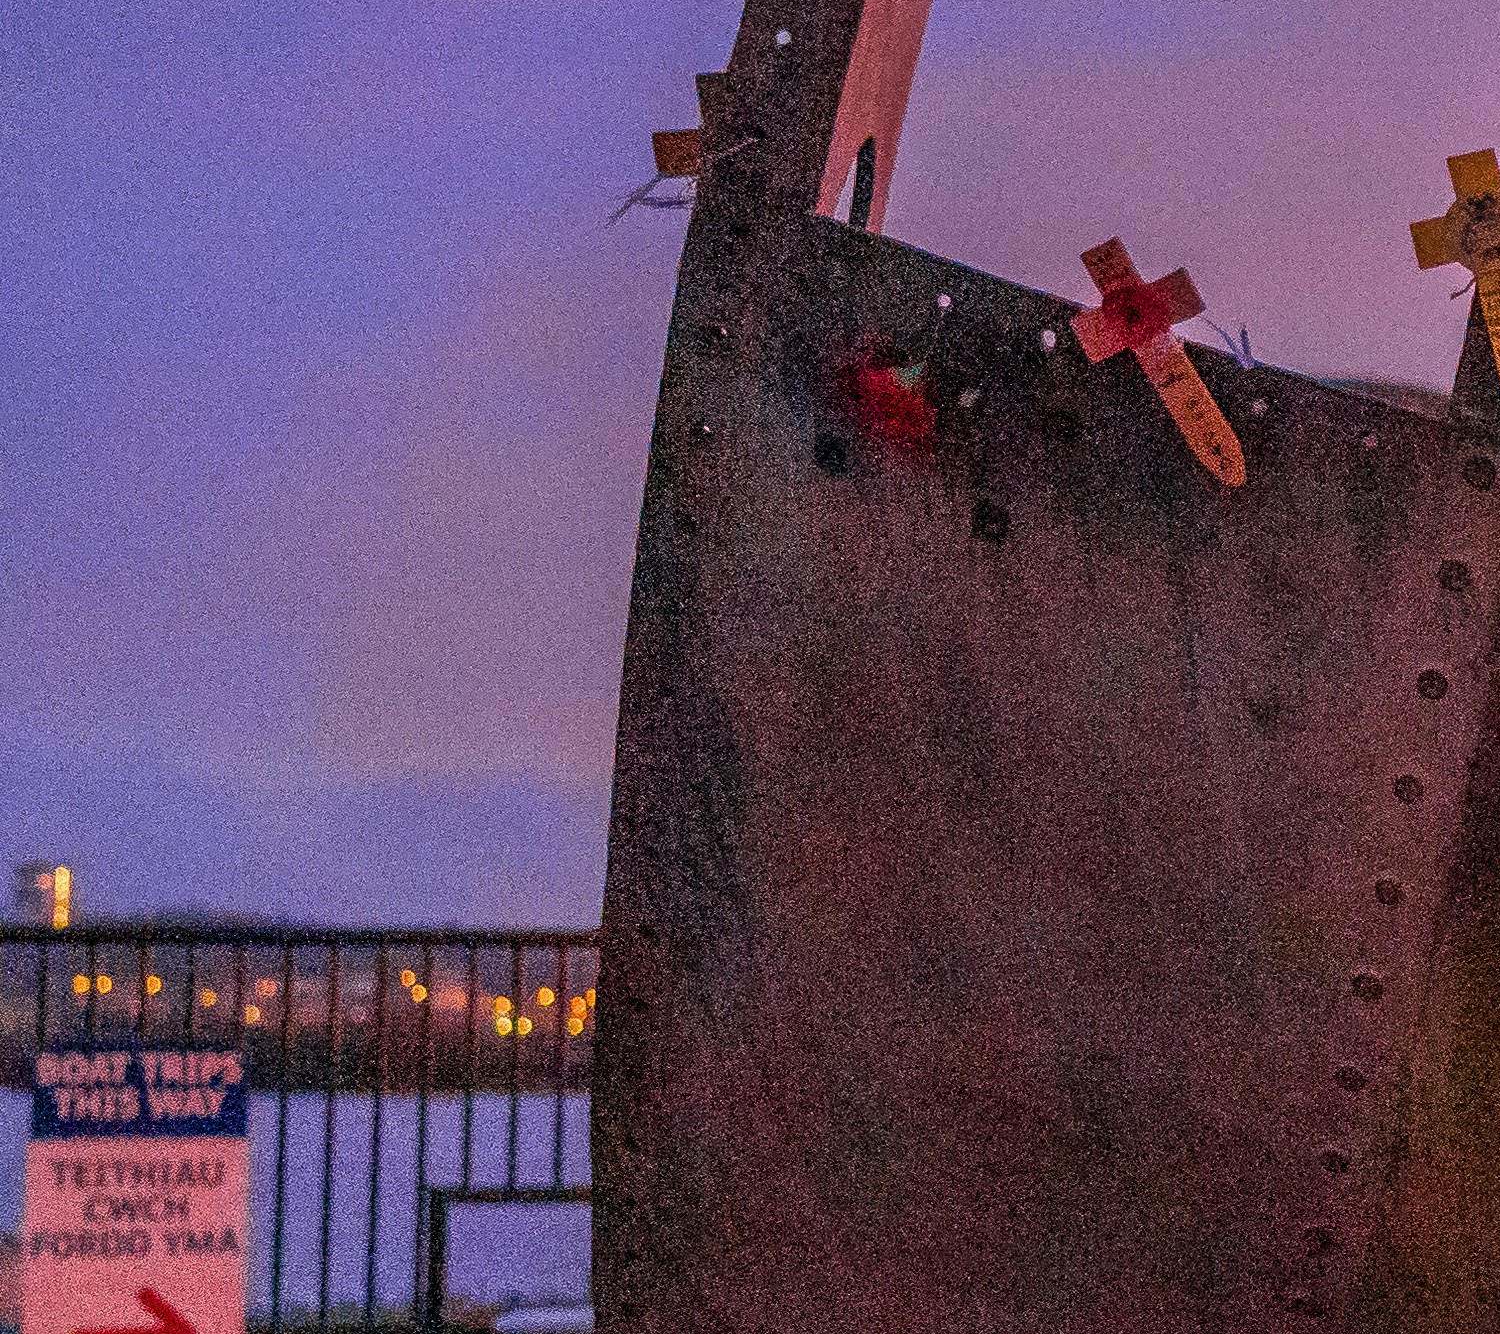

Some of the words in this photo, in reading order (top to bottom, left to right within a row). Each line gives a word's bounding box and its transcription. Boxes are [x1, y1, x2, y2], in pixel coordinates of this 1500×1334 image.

[36, 1052, 131, 1086] BOAT
[140, 1050, 243, 1086] TRIPS
[54, 1087, 140, 1120] THIS
[147, 1087, 227, 1119] WAY
[51, 1159, 227, 1188] TEITHIAU
[83, 1195, 191, 1222] CWCH
[163, 1228, 239, 1254] YMA
